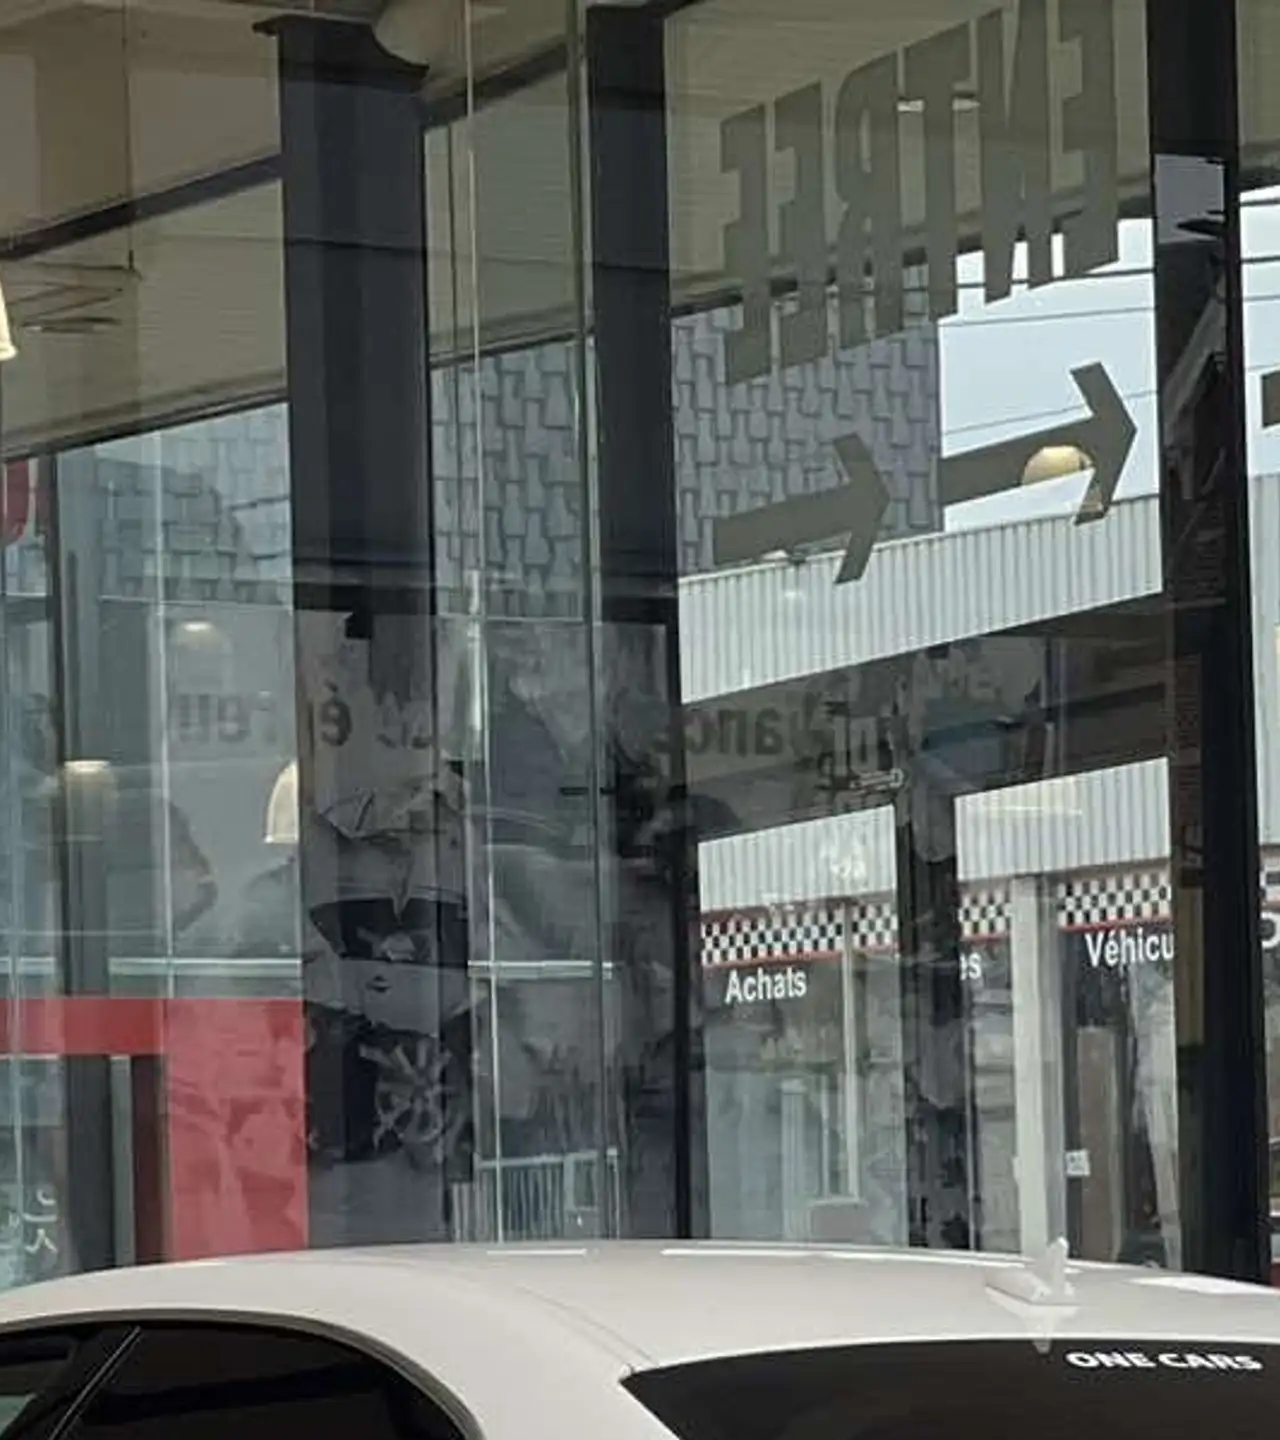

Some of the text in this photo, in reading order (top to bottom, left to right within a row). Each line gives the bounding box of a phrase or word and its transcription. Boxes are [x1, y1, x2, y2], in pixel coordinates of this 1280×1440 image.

[724, 965, 808, 1005] Achats
[1065, 1351, 1264, 1371] ONE CARS
